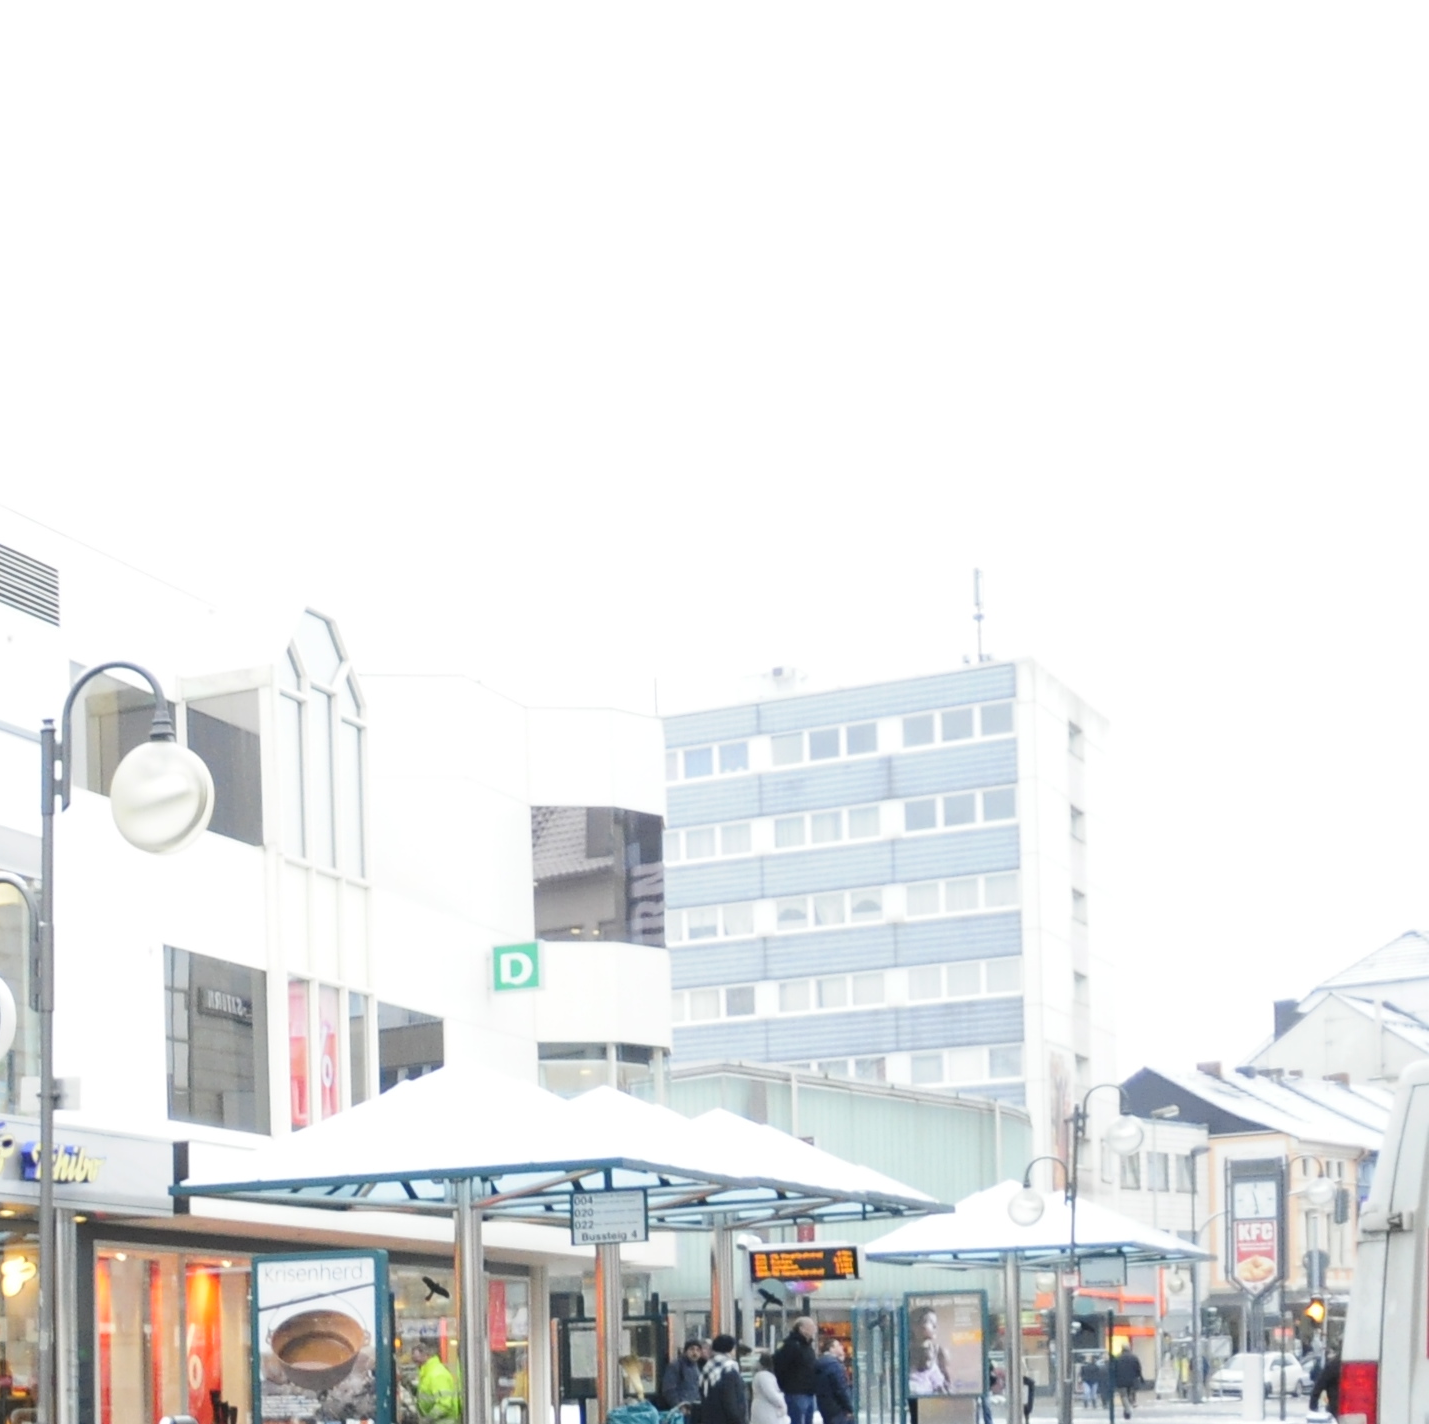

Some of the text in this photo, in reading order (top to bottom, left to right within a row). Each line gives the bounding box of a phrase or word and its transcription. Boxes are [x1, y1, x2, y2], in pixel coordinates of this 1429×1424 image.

[581, 1231, 627, 1242] Bussteig
[1237, 1222, 1274, 1241] KFC
[263, 1262, 369, 1285] Krisenherd.
